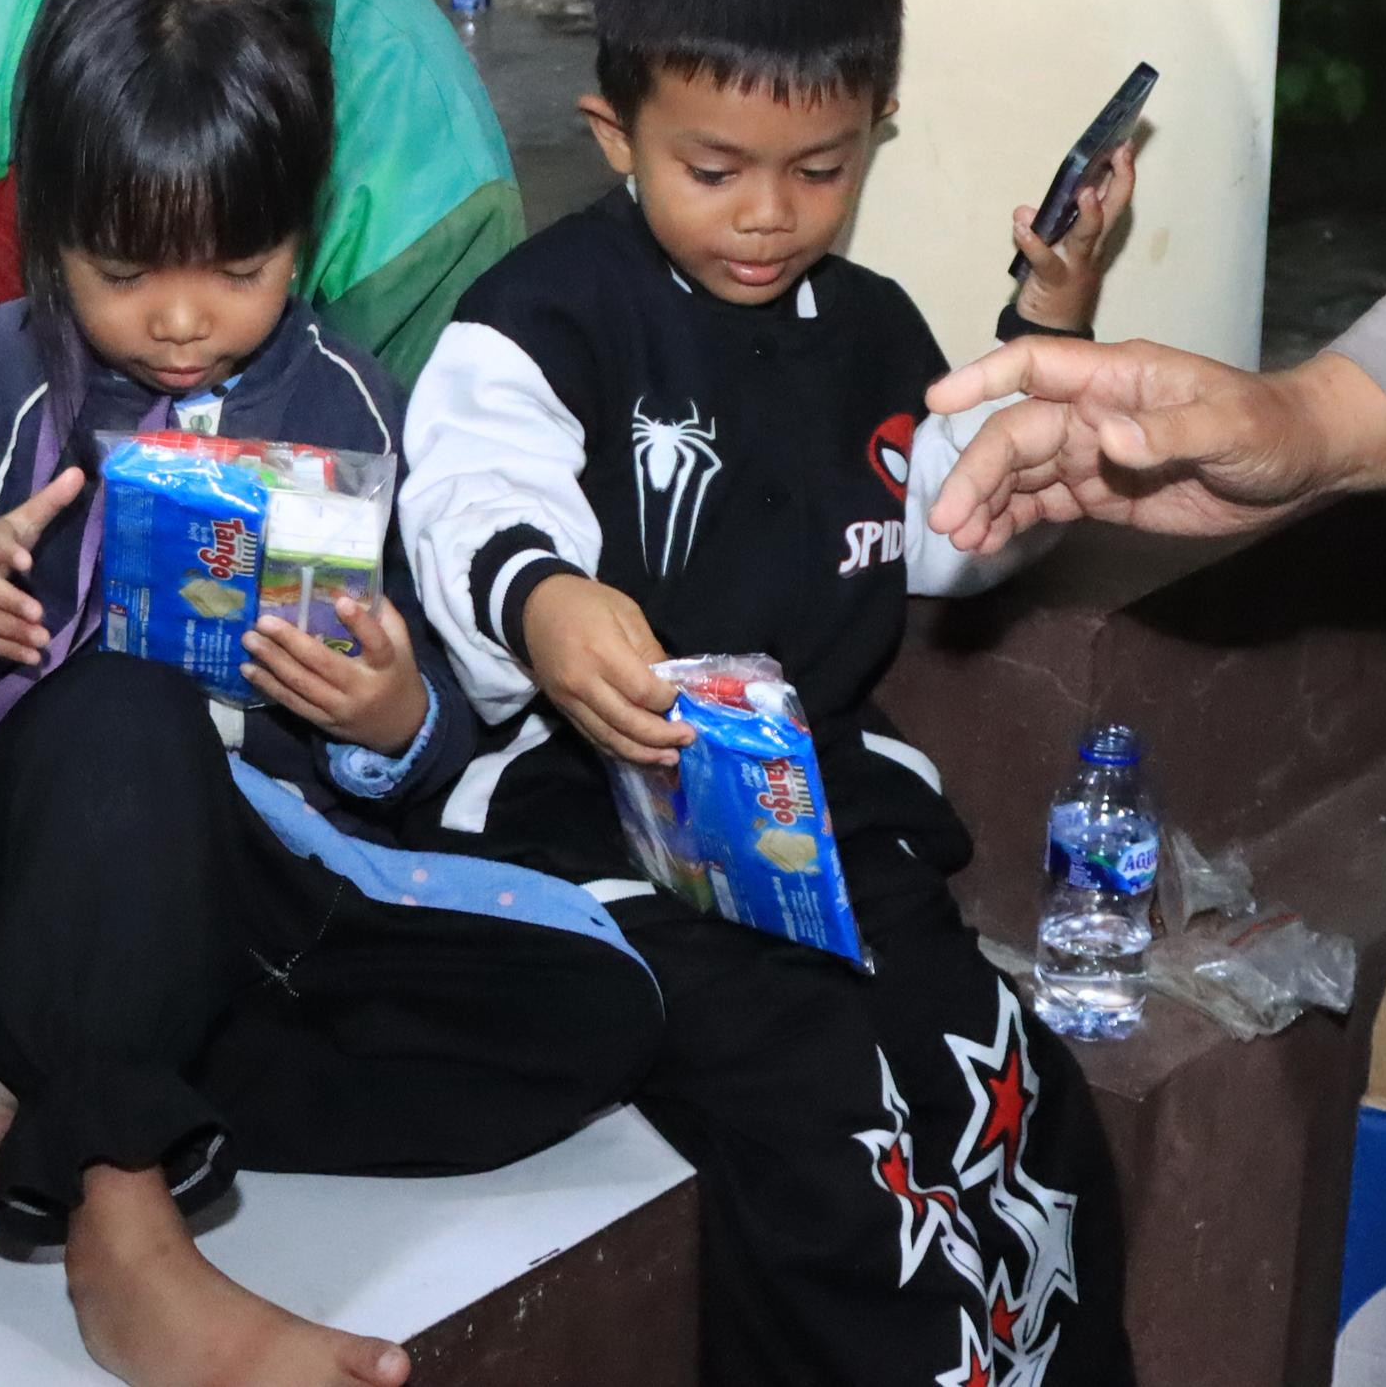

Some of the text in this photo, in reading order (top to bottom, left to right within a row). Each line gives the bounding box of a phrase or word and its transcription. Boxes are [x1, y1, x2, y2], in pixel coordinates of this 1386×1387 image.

[198, 518, 244, 581] Tango
[757, 756, 797, 826] Tango
[1123, 849, 1158, 873] AQU
